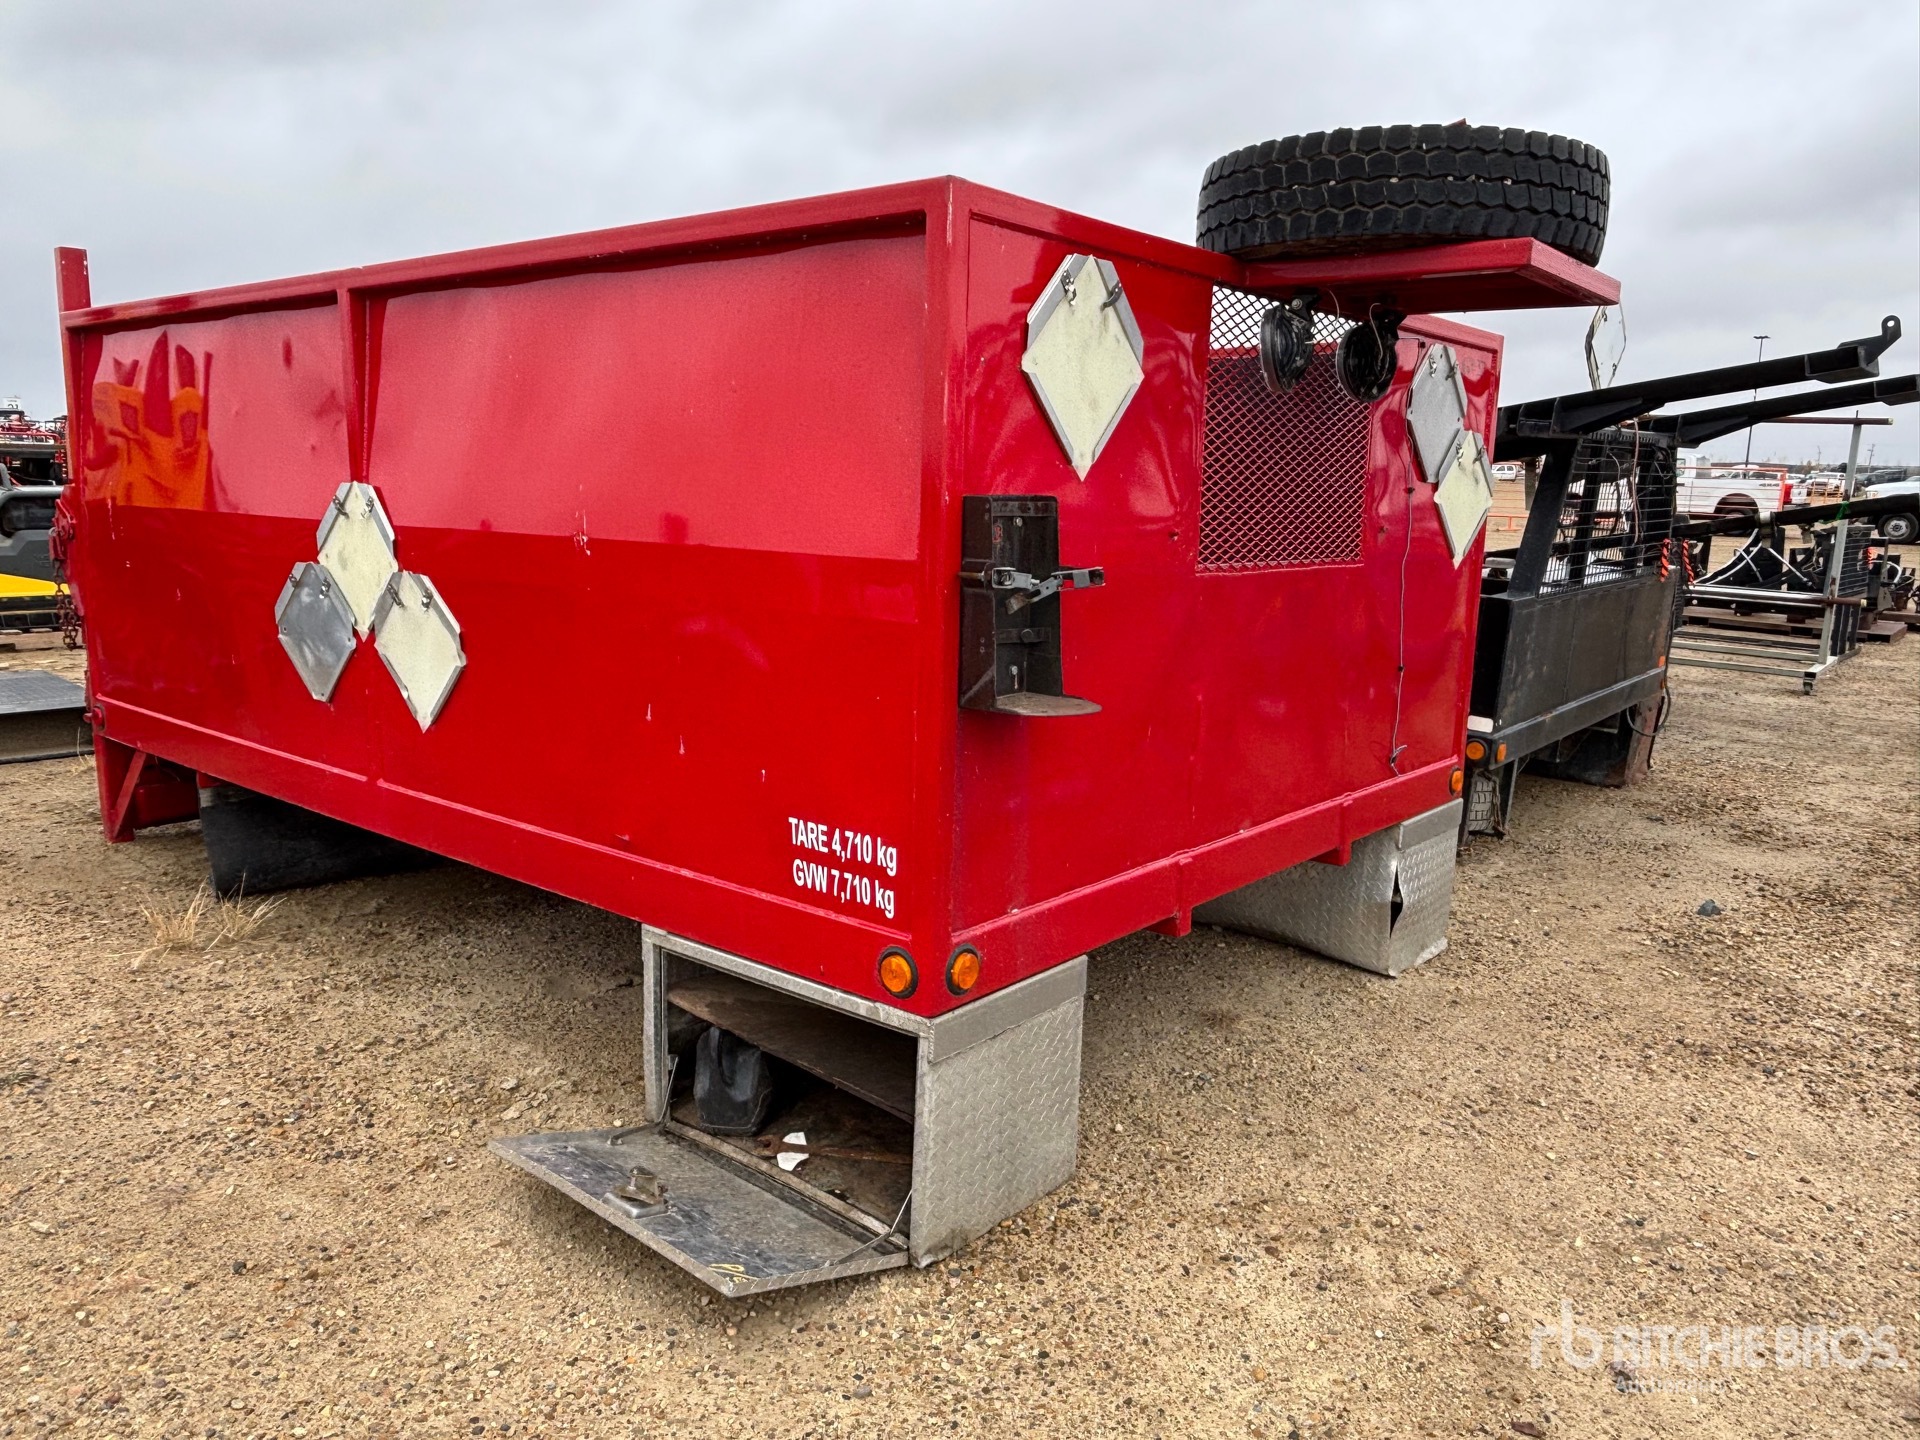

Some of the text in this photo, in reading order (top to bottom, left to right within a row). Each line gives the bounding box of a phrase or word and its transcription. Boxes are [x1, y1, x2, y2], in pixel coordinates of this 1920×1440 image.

[788, 816, 897, 877] TARE 4,710 kg
[792, 858, 895, 919] GVW 7,710 kg
